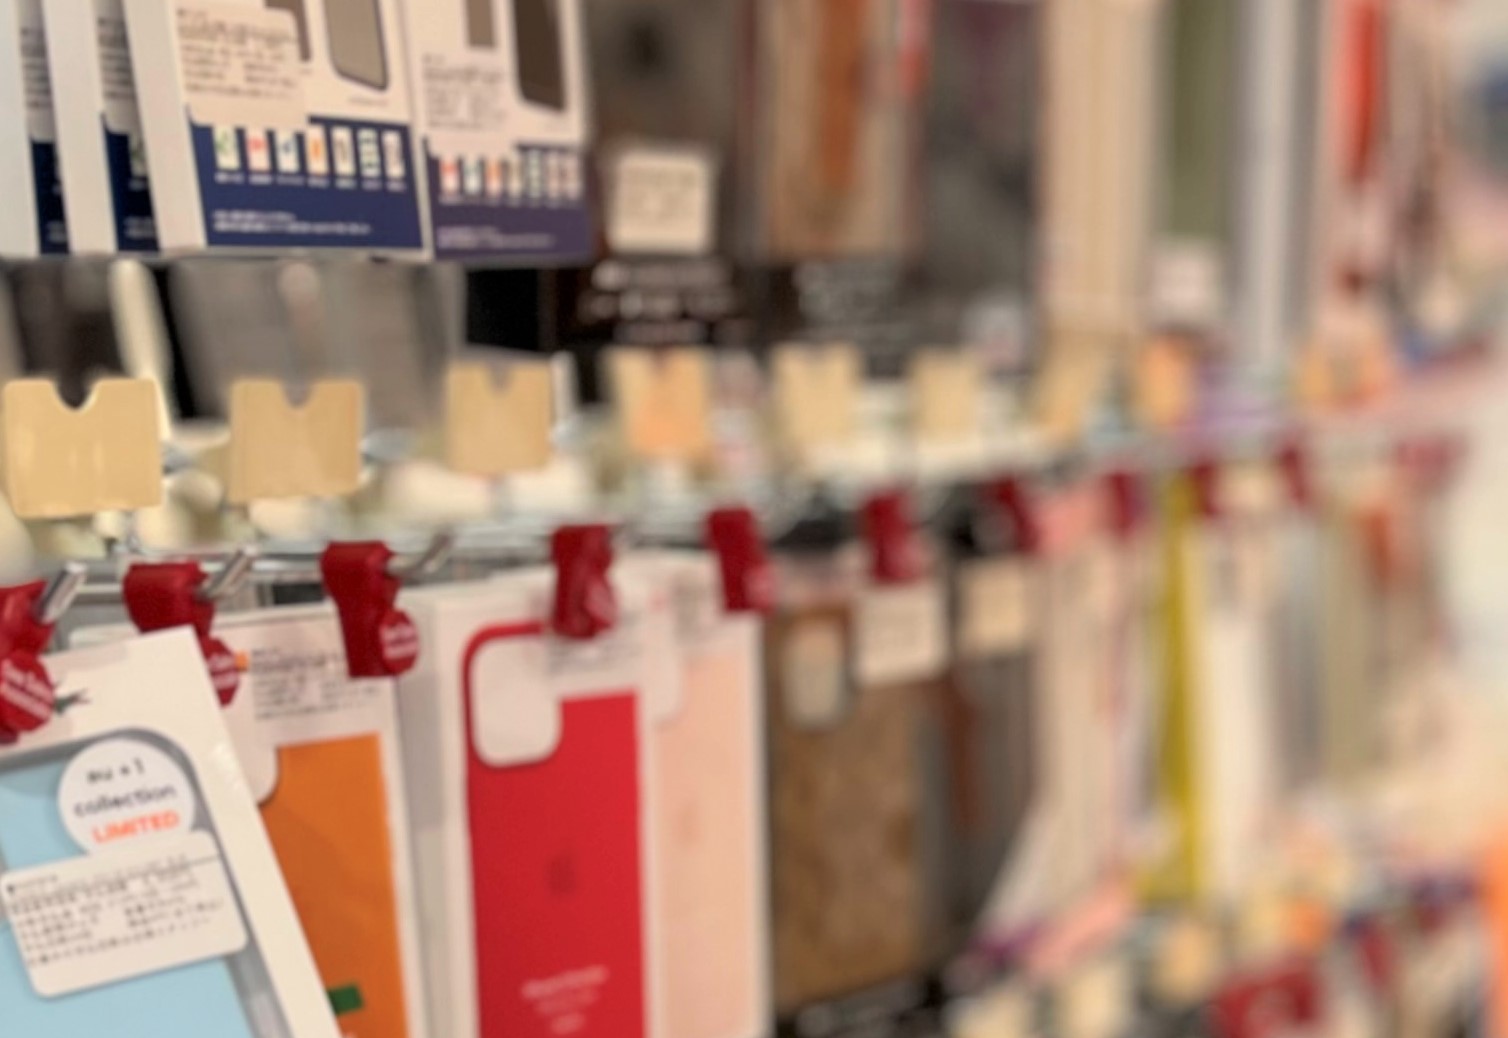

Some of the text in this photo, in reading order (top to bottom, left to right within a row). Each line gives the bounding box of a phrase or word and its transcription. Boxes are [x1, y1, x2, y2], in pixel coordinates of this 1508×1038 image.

[87, 766, 113, 784] au
[73, 784, 176, 818] collection
[91, 809, 180, 844] LIMITED
